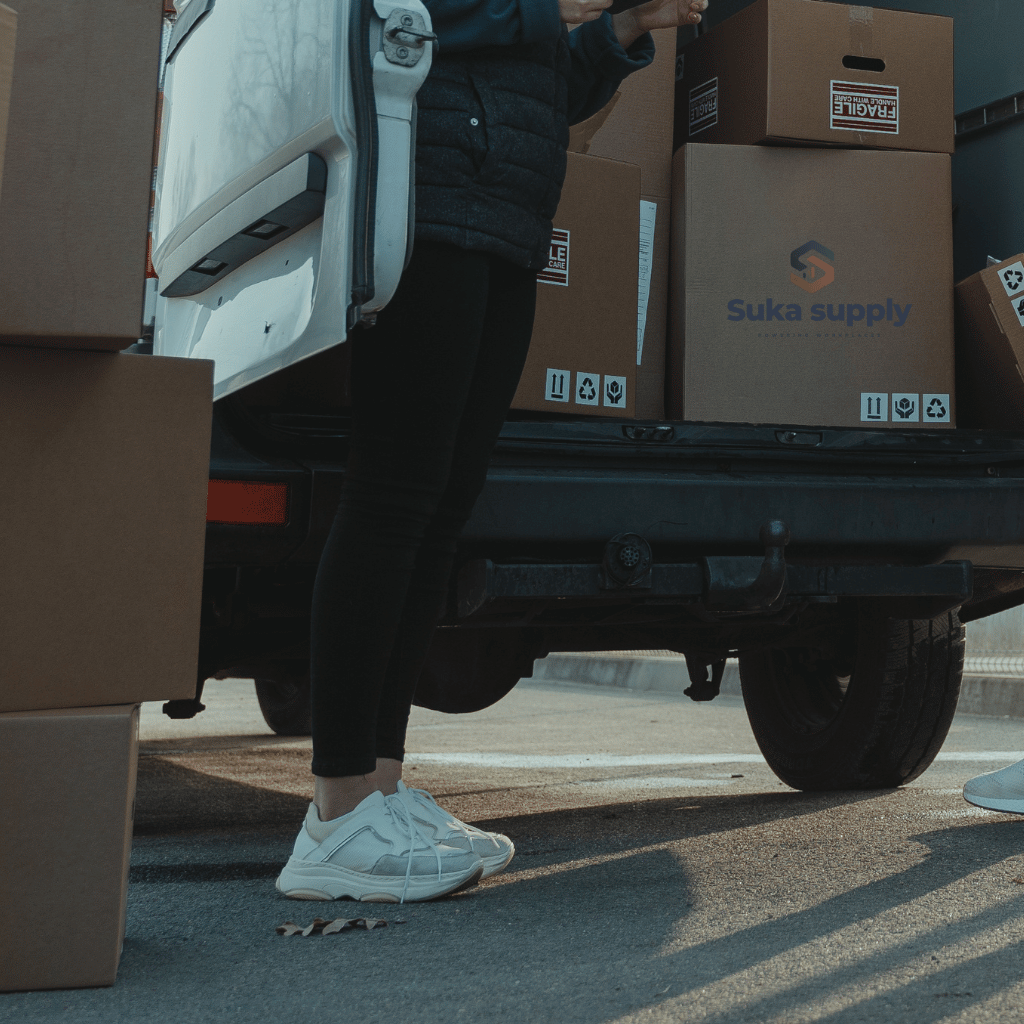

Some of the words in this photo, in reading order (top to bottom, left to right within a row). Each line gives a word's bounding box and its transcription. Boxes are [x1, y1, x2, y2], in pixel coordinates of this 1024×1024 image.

[834, 94, 852, 102] CARE
[871, 98, 896, 106] HANDLE
[833, 101, 896, 119] FRAGILE
[548, 261, 566, 269] CARE
[727, 298, 802, 322] Suka
[810, 298, 913, 327] supply
